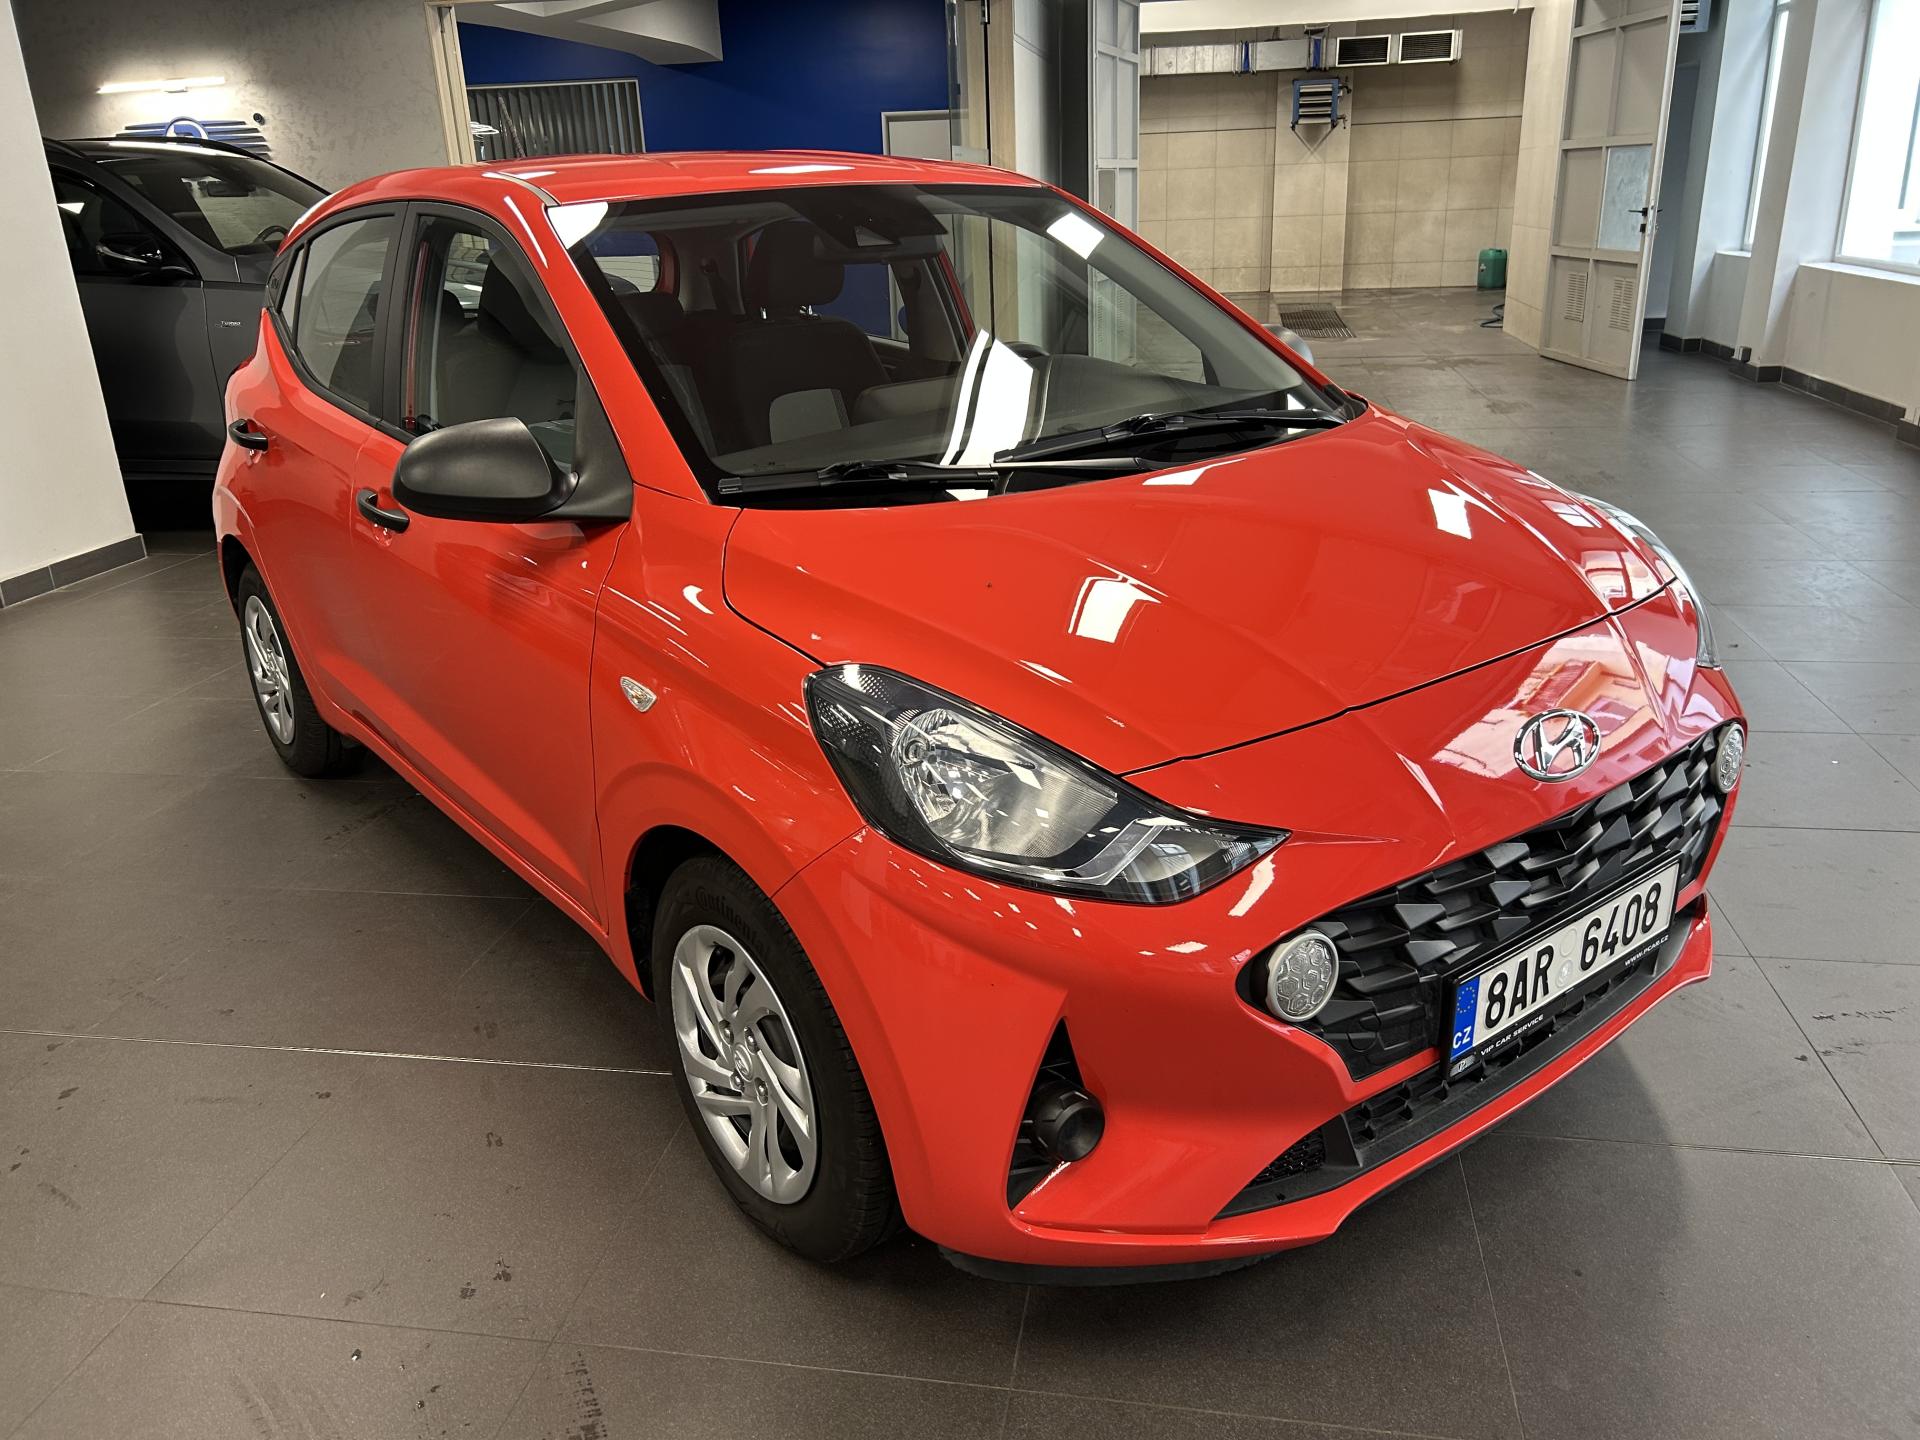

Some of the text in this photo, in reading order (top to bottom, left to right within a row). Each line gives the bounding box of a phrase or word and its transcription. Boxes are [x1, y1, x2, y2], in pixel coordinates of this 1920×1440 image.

[696, 886, 770, 962] Continental
[1483, 881, 1661, 1029] 8AR 6408
[1453, 1026, 1472, 1049] CZ
[1481, 1014, 1544, 1056] VIP CAR SERVICE
